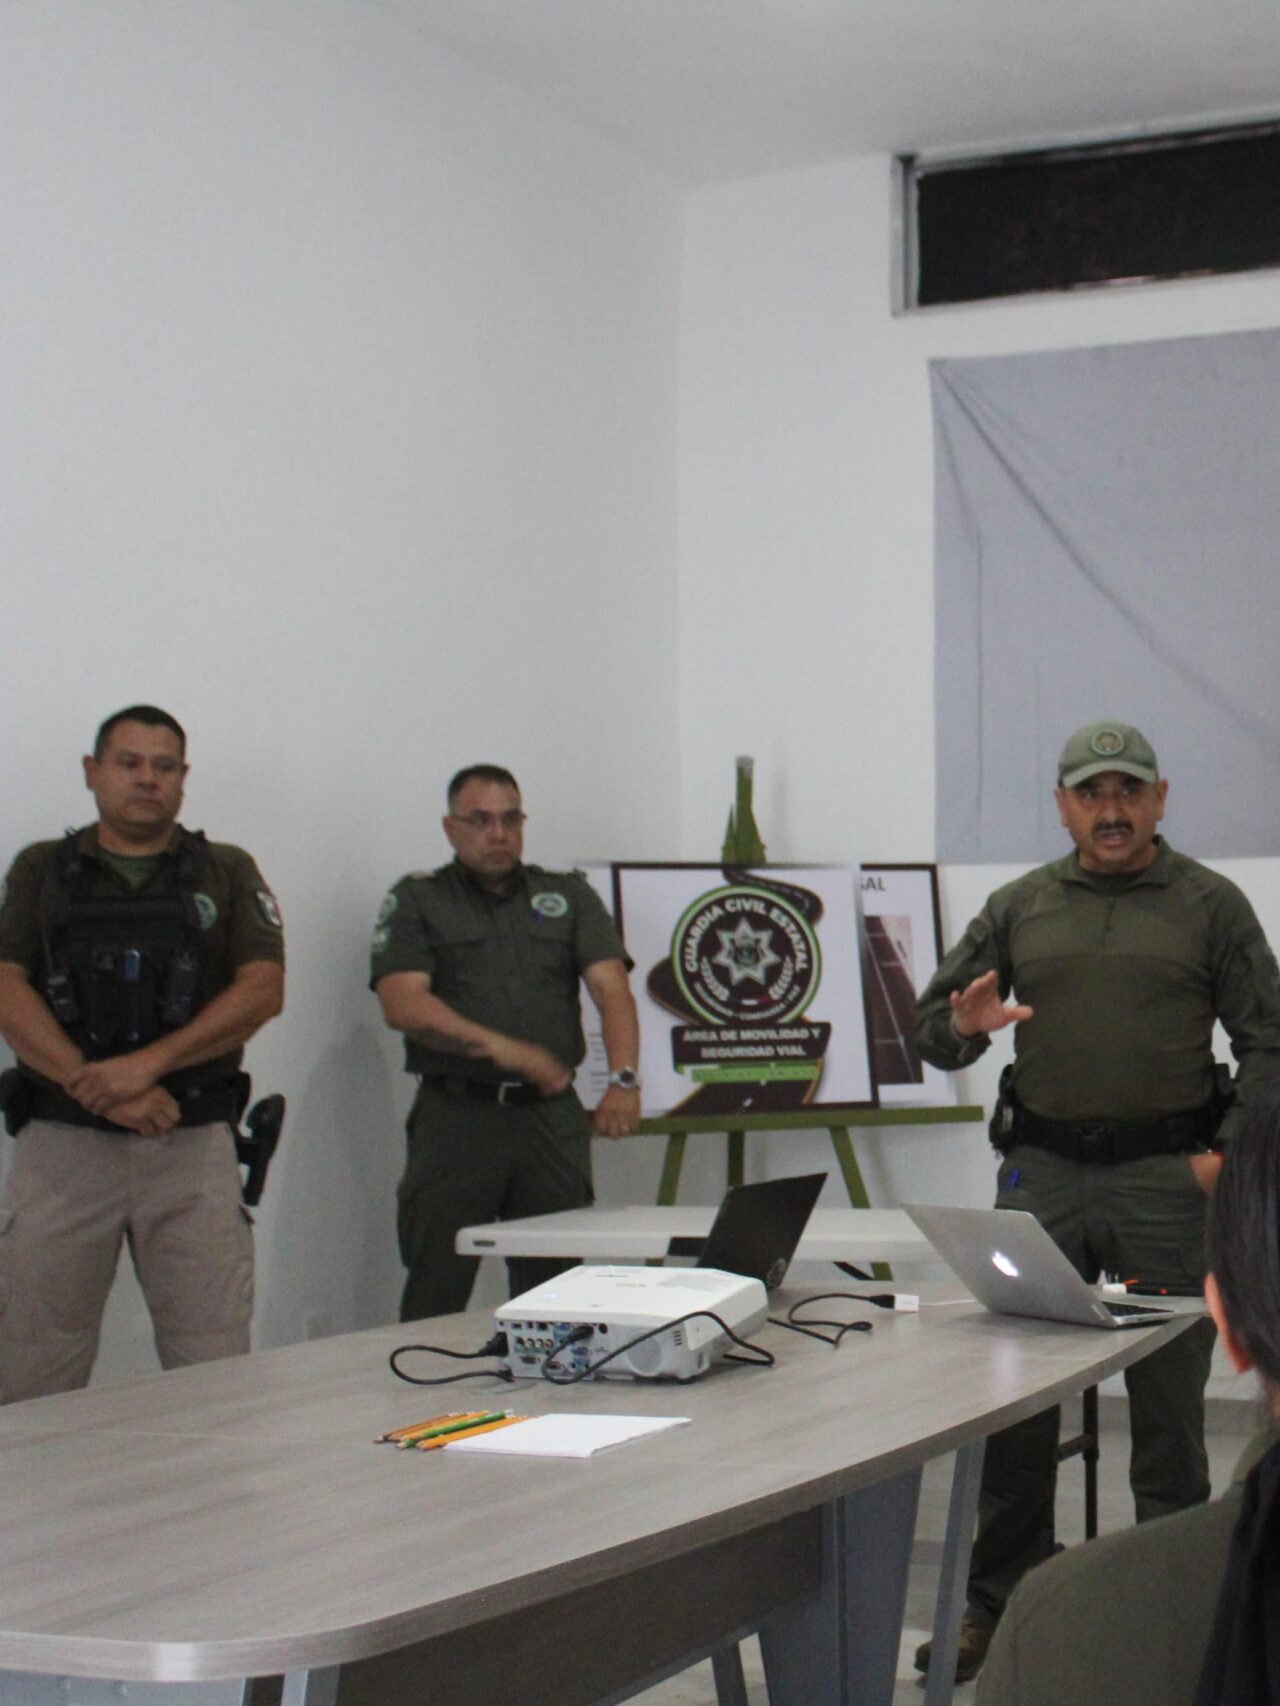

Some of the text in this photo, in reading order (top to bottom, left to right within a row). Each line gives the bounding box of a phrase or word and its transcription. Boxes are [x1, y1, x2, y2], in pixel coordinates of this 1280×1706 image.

[683, 898, 809, 973] GUARDIA CIVIL ESTATAL
[720, 1029, 738, 1041] DE
[740, 1028, 810, 1040] MOVILIDAD
[811, 1028, 821, 1038] Y
[700, 1045, 807, 1058] SEGURIDAD VIAL
